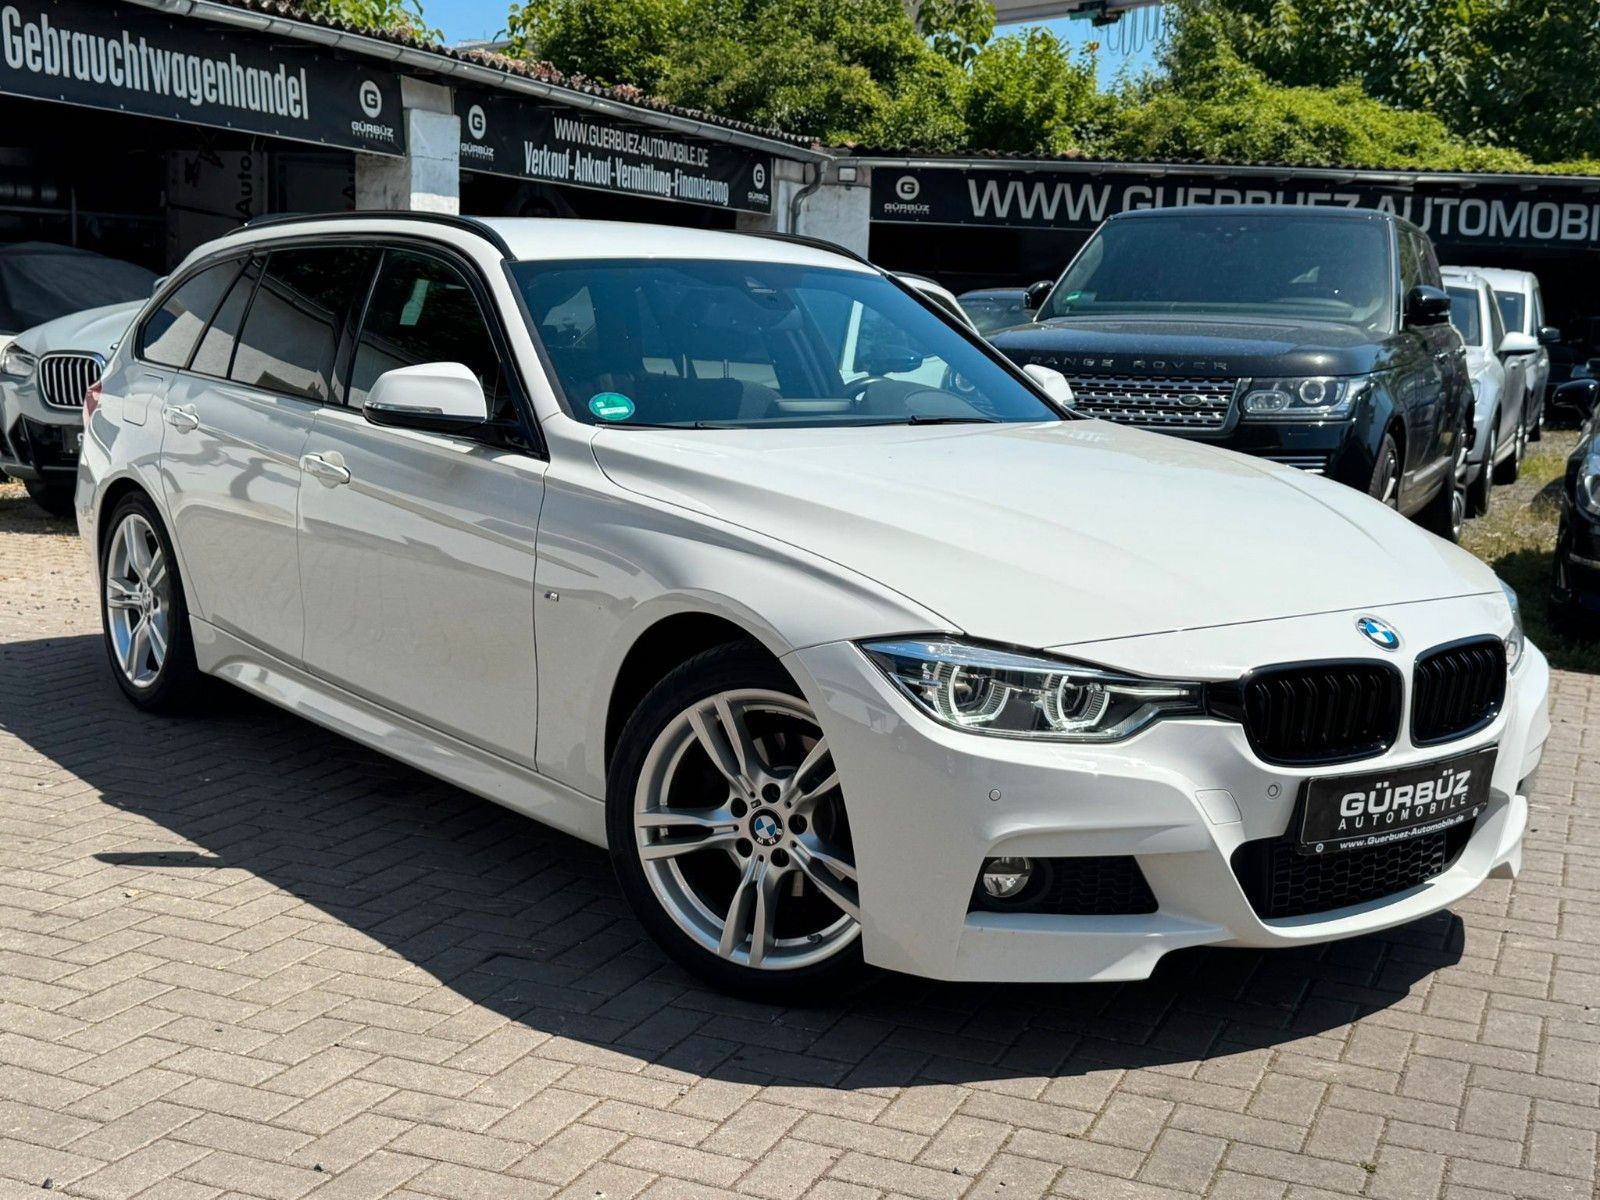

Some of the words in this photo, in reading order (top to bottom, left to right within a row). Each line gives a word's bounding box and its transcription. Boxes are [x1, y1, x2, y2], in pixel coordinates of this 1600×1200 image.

[1, 5, 310, 121] Gebrauchtwagenhandel
[554, 117, 709, 168] WWW.GUERBUEZ-AUTOMOBILE.DE
[524, 141, 729, 206] Verkauf-Ankauf-Vermittlung-Finanzierung
[1029, 356, 1115, 368] RANGE
[1133, 360, 1227, 370] ROVER
[1338, 793, 1467, 830] AUTOMOBILE
[1340, 769, 1471, 817] GÜRBÜZ
[1340, 814, 1464, 849] www.Guerbuez-Automobile.de
